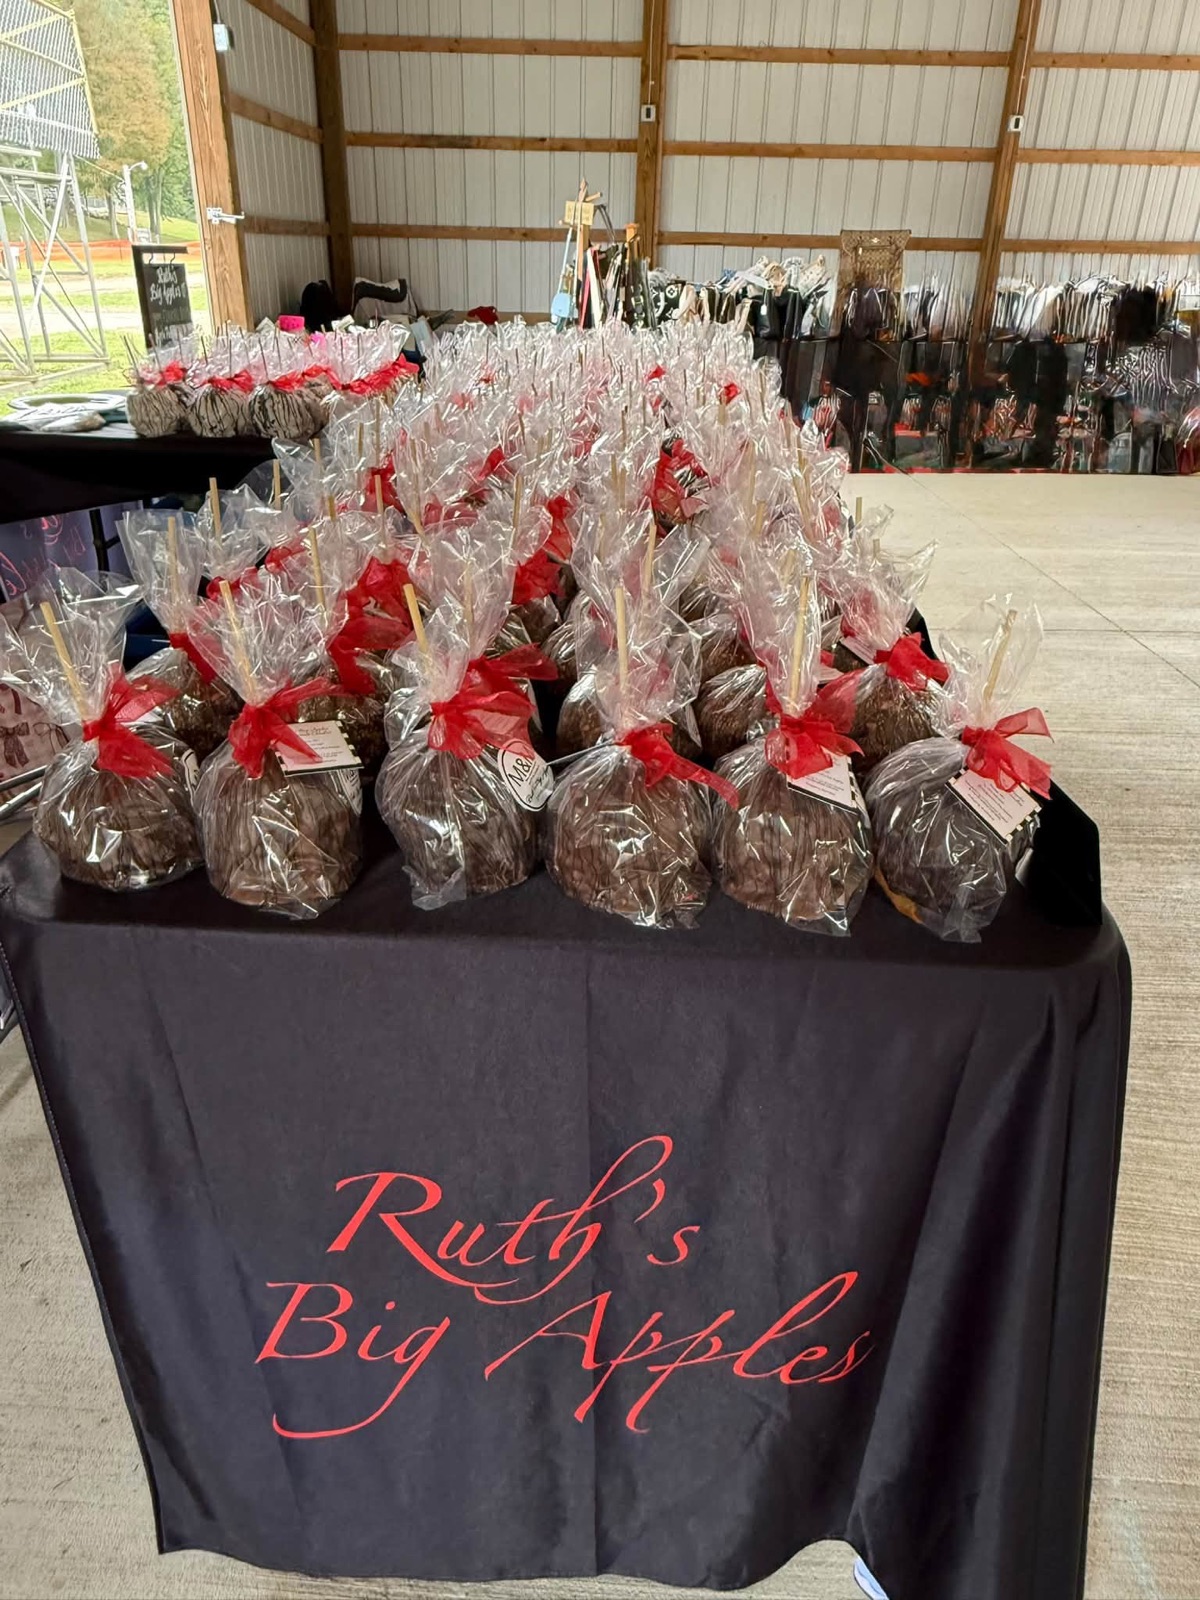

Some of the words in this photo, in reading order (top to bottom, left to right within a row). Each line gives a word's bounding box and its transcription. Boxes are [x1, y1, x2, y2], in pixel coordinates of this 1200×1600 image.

[328, 1135, 699, 1305] Ruth's
[256, 1282, 450, 1439] Big
[484, 1271, 874, 1434] Apples
